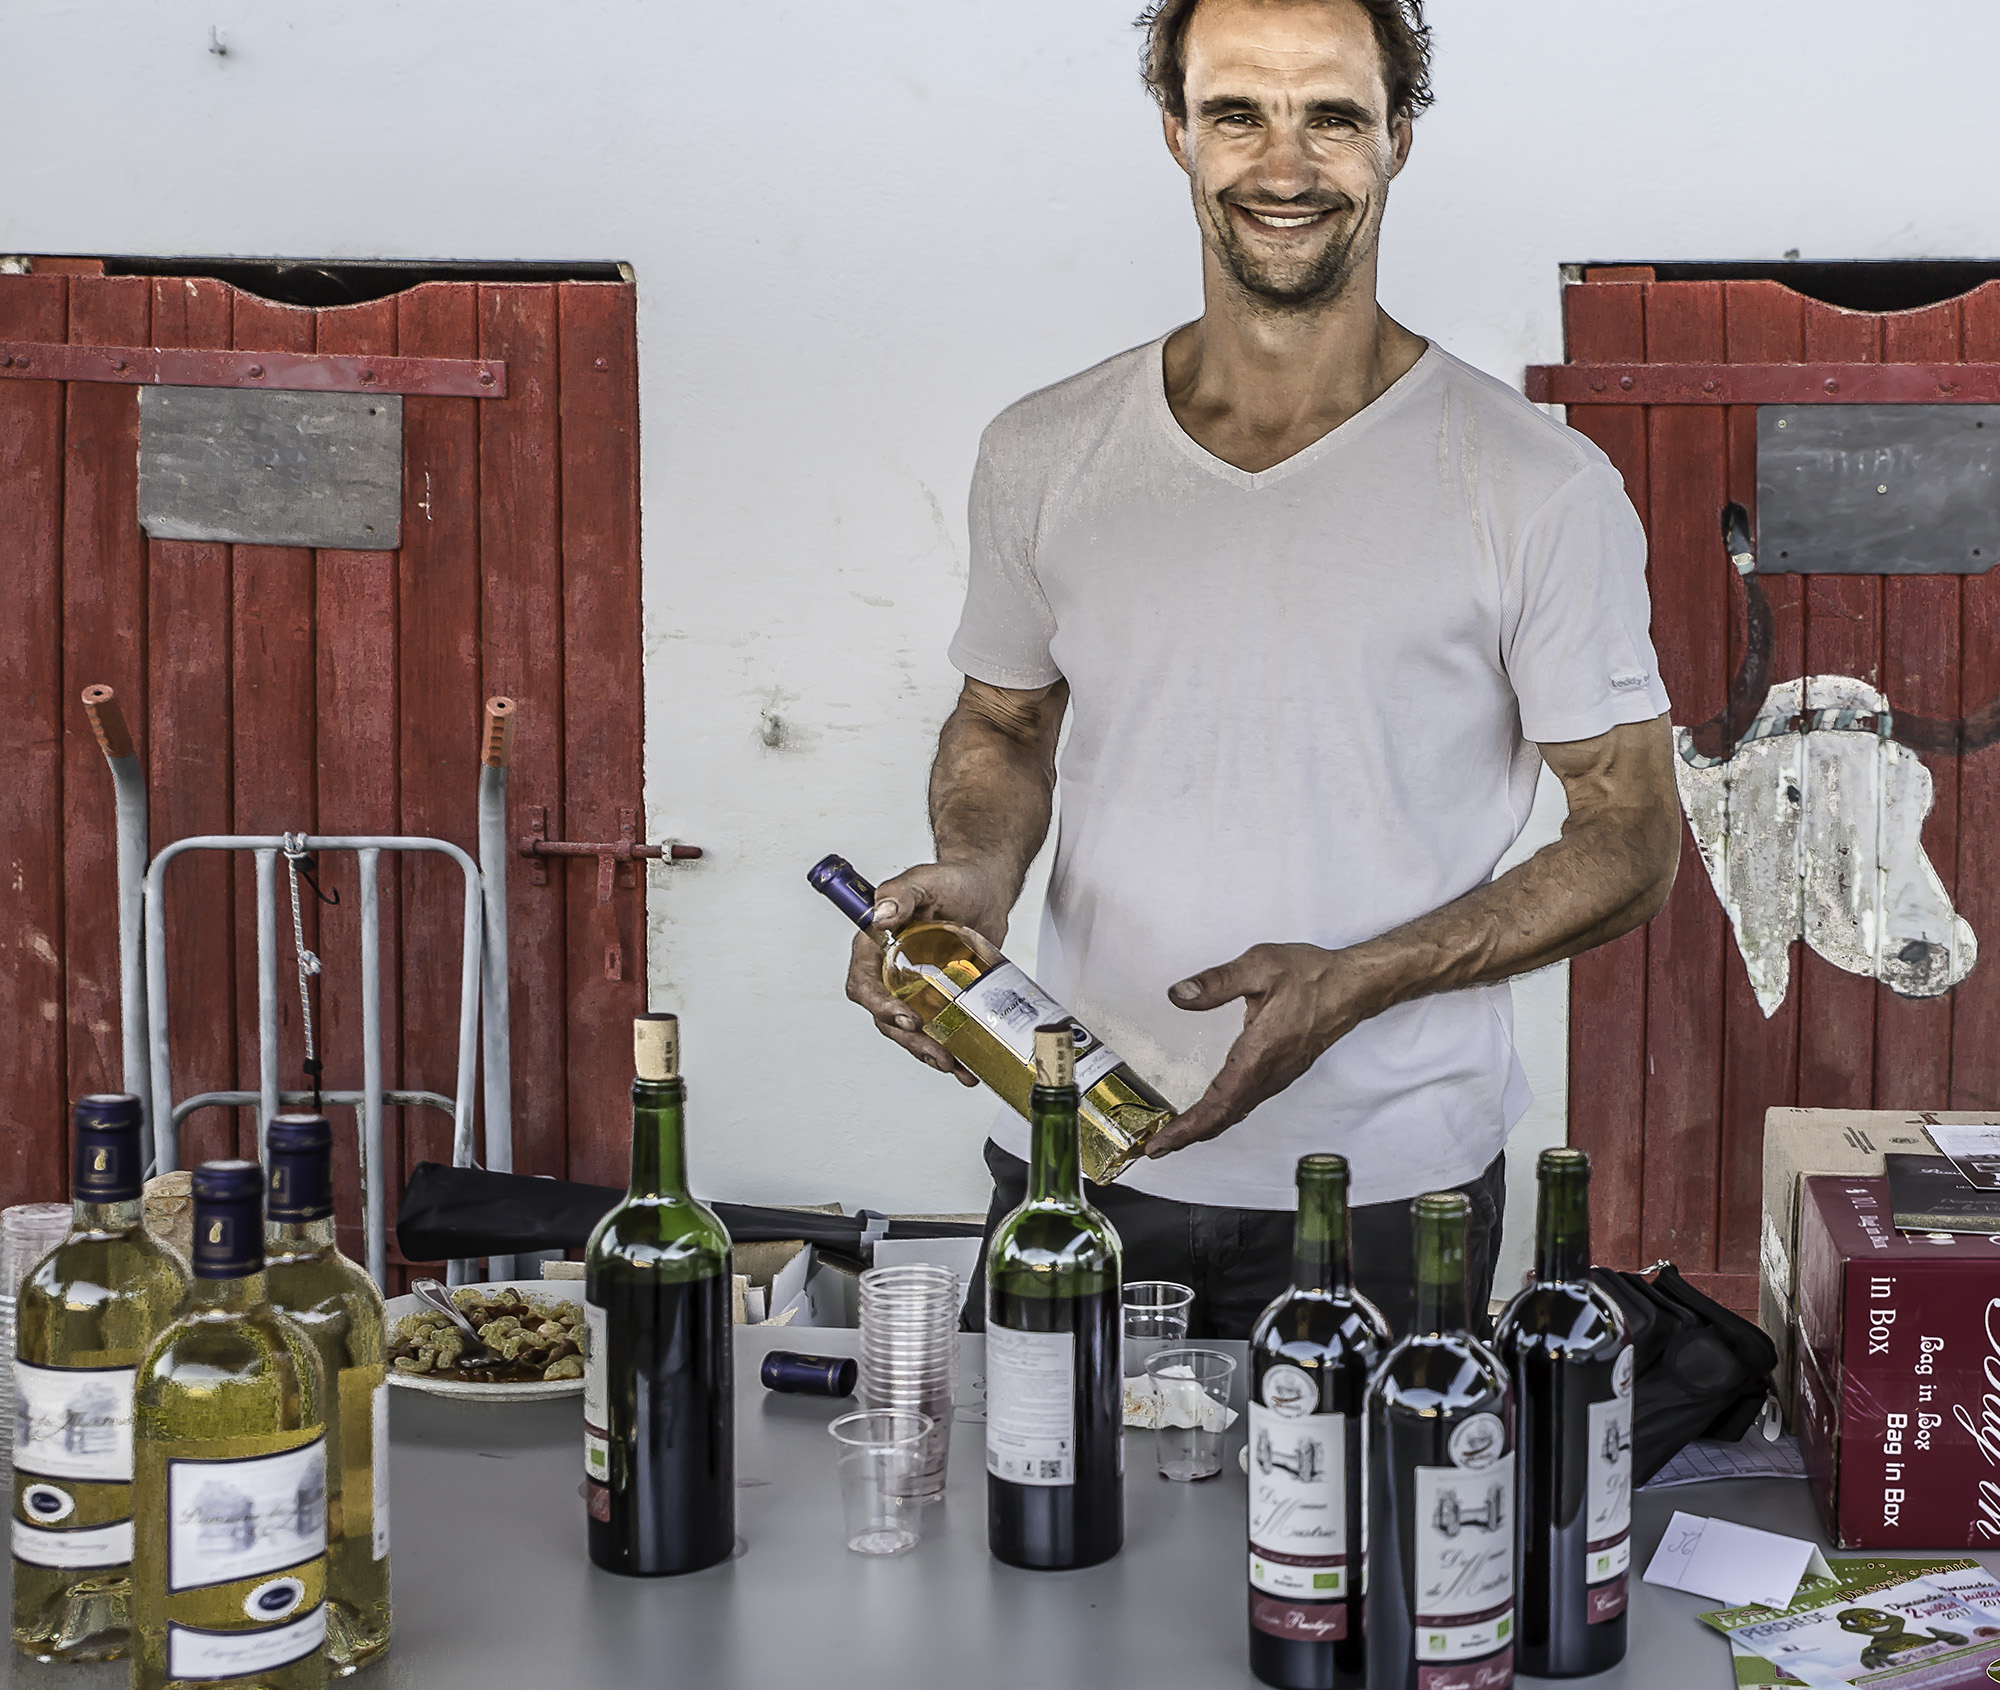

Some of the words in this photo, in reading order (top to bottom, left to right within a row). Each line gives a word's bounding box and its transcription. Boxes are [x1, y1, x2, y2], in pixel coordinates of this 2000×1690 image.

[1870, 1276, 1897, 1298] in
[1868, 1308, 1896, 1355] Box
[1914, 1335, 1945, 1376] Bag
[1918, 1384, 1938, 1403] in
[1883, 1413, 1908, 1455] Bag
[1914, 1412, 1943, 1451] Box
[1885, 1462, 1905, 1481] in
[1883, 1488, 1905, 1527] Box
[1904, 1607, 1924, 1619] 2
